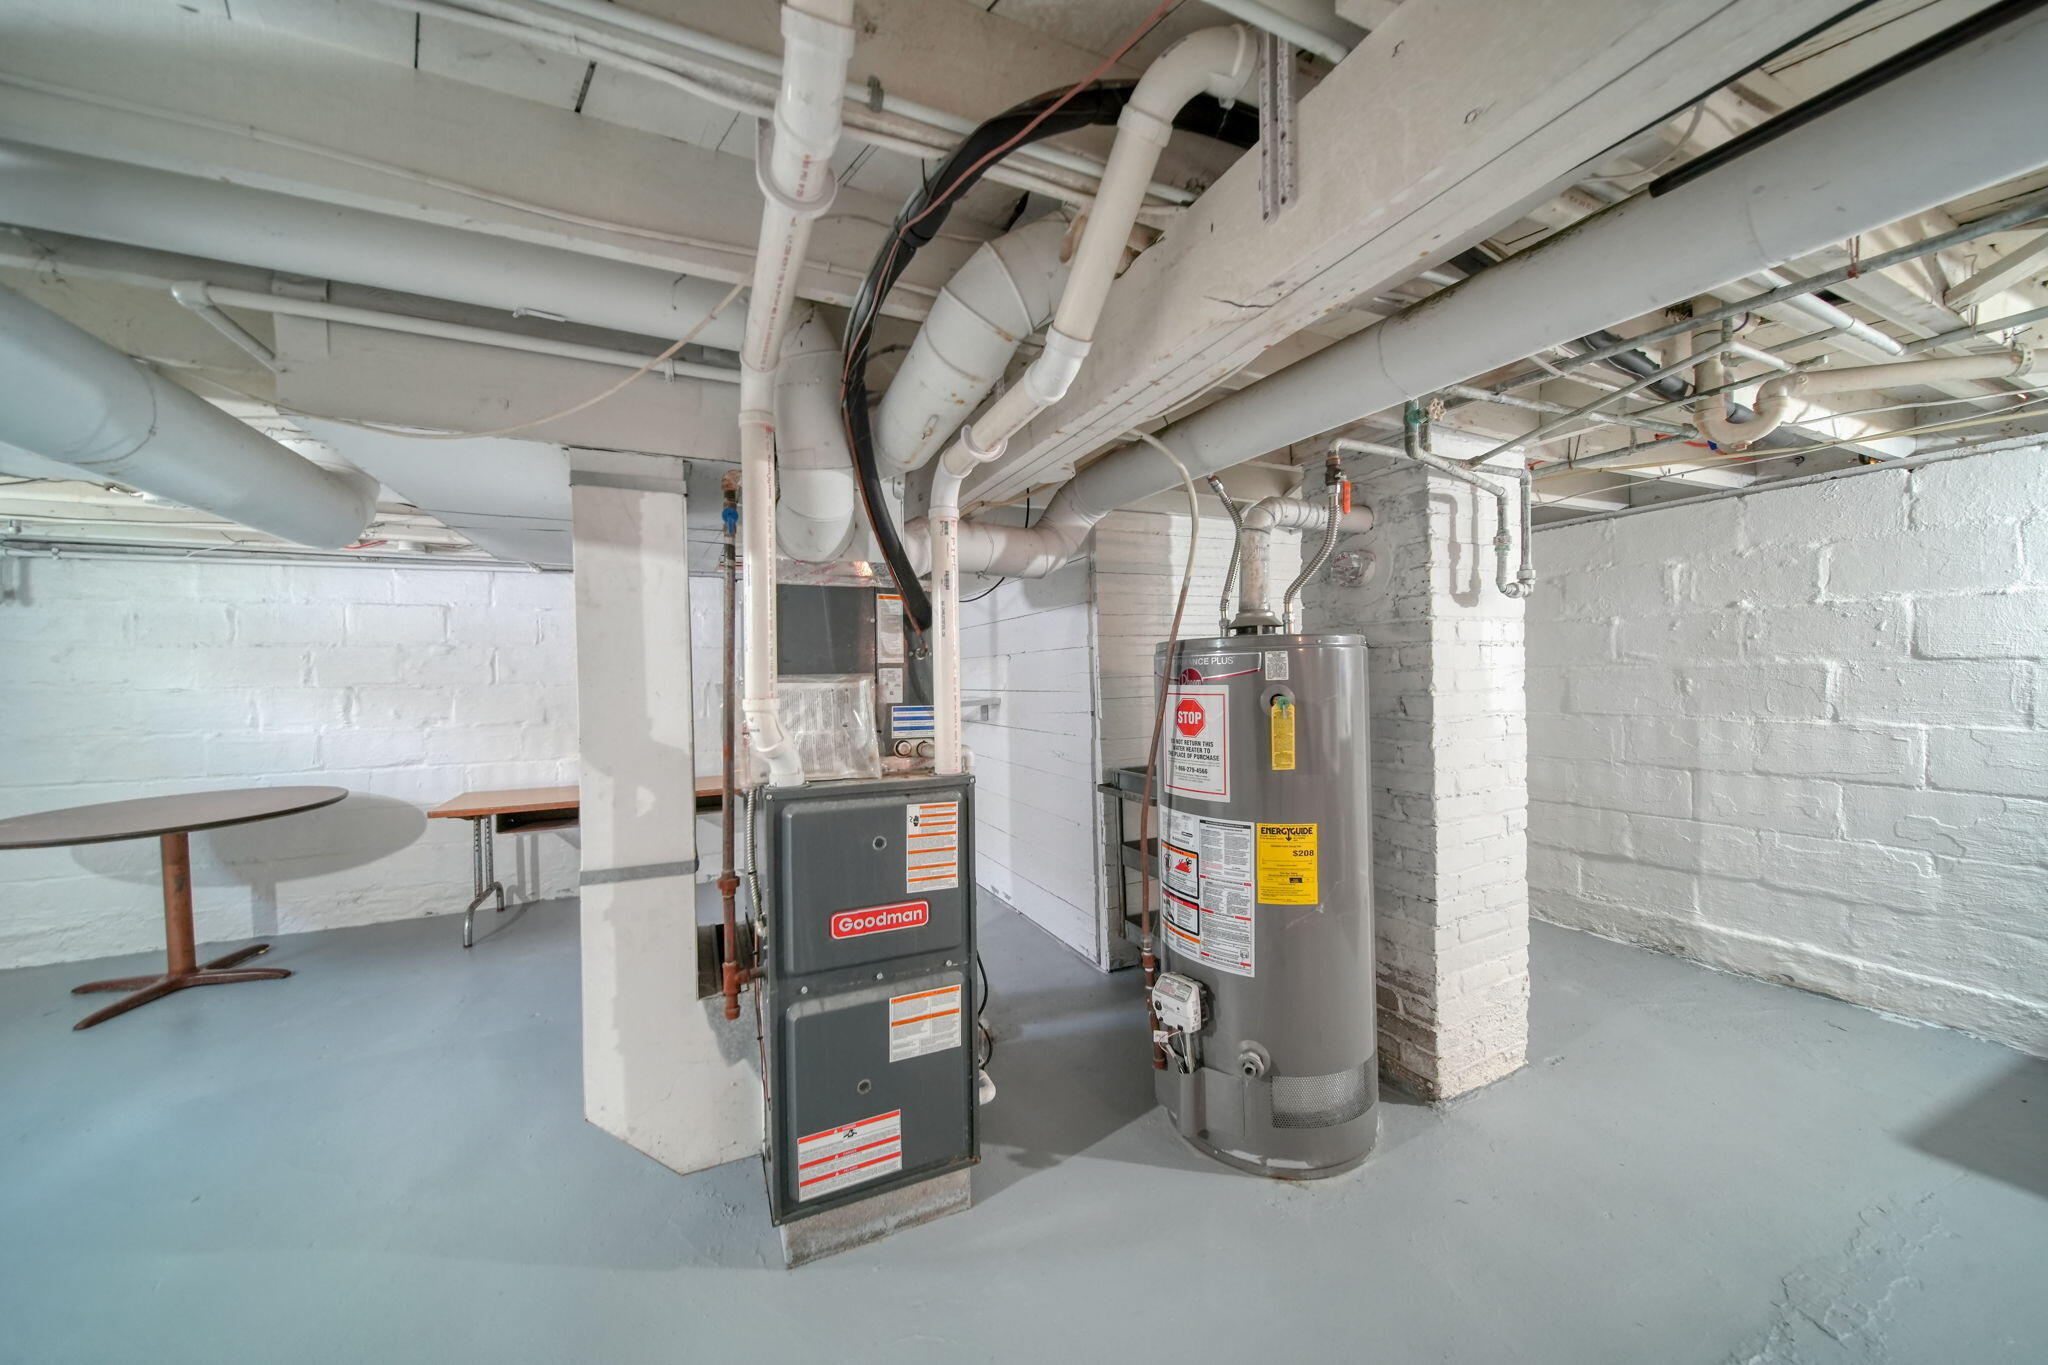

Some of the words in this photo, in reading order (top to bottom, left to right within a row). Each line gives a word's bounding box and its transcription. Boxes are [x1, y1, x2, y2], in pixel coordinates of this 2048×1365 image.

[1211, 656, 1234, 665] PLUS
[1177, 710, 1202, 725] STOP
[1260, 827, 1313, 835] ENERGYGUIDE
[838, 909, 923, 932] Goodman
